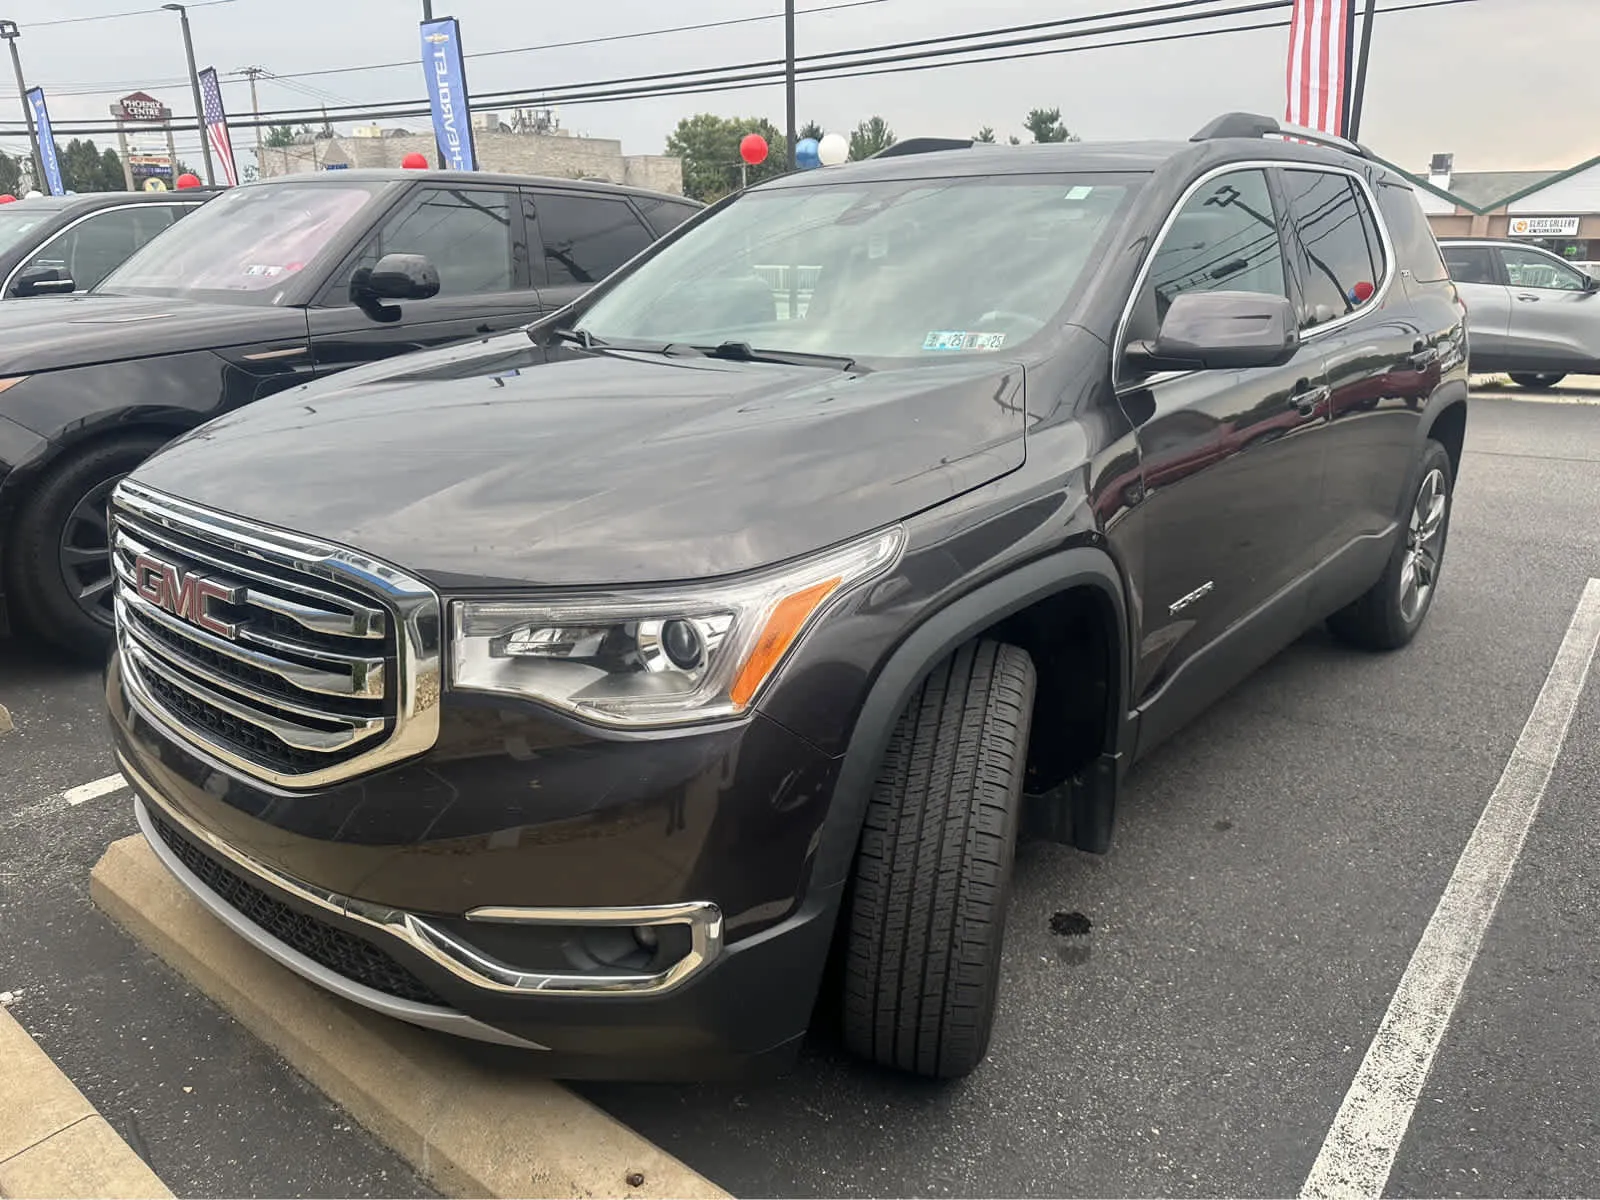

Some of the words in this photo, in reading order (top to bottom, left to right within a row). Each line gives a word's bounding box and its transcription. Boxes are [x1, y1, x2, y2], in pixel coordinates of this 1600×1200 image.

[122, 99, 162, 109] PHOENIX
[127, 107, 160, 116] CENTRE
[1529, 219, 1547, 228] GLASS
[1549, 219, 1576, 228] GALLERY
[136, 554, 236, 640] GMC
